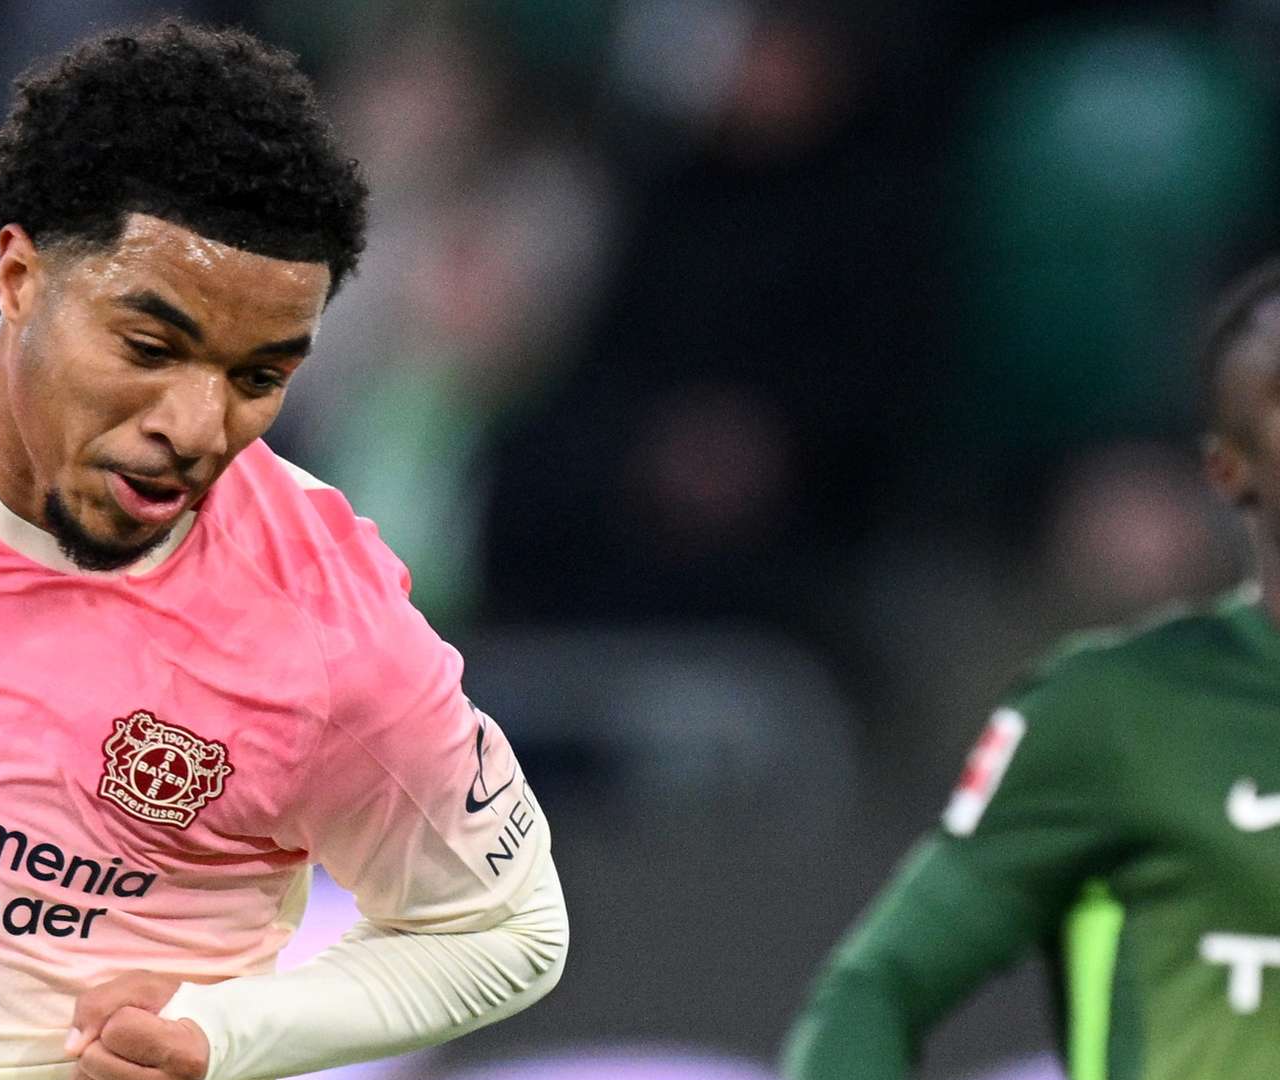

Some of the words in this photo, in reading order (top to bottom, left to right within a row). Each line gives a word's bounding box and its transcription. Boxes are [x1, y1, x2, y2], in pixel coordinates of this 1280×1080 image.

[163, 732, 191, 750] 1904
[136, 761, 186, 788] BAYER
[146, 750, 177, 799] BAYER
[108, 782, 184, 822] Leverkusen
